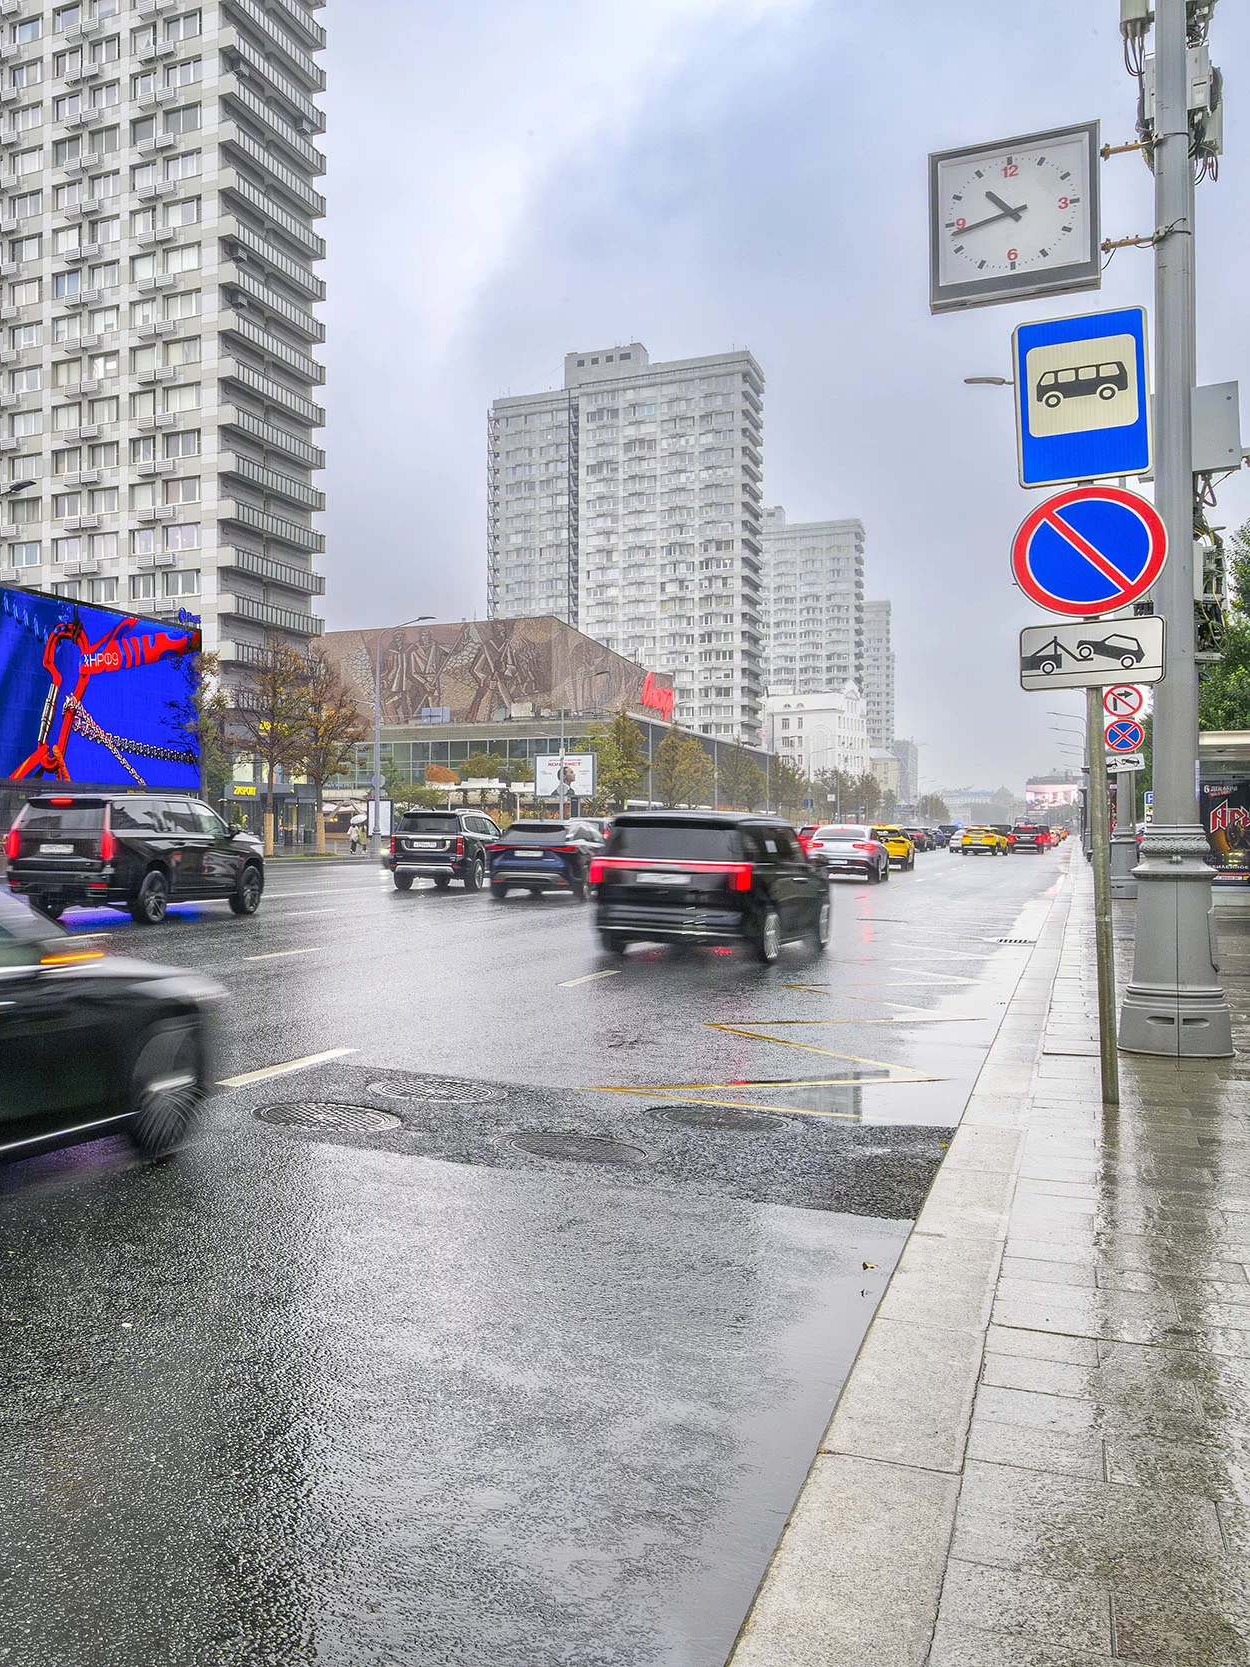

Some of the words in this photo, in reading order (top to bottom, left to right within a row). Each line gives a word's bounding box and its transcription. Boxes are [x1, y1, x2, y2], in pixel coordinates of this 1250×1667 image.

[1001, 164, 1019, 178] 12
[1058, 197, 1069, 210] 3
[956, 217, 966, 230] 9
[1007, 248, 1018, 261] 6
[90, 652, 119, 667] НРФ9
[1203, 784, 1210, 793] 6
